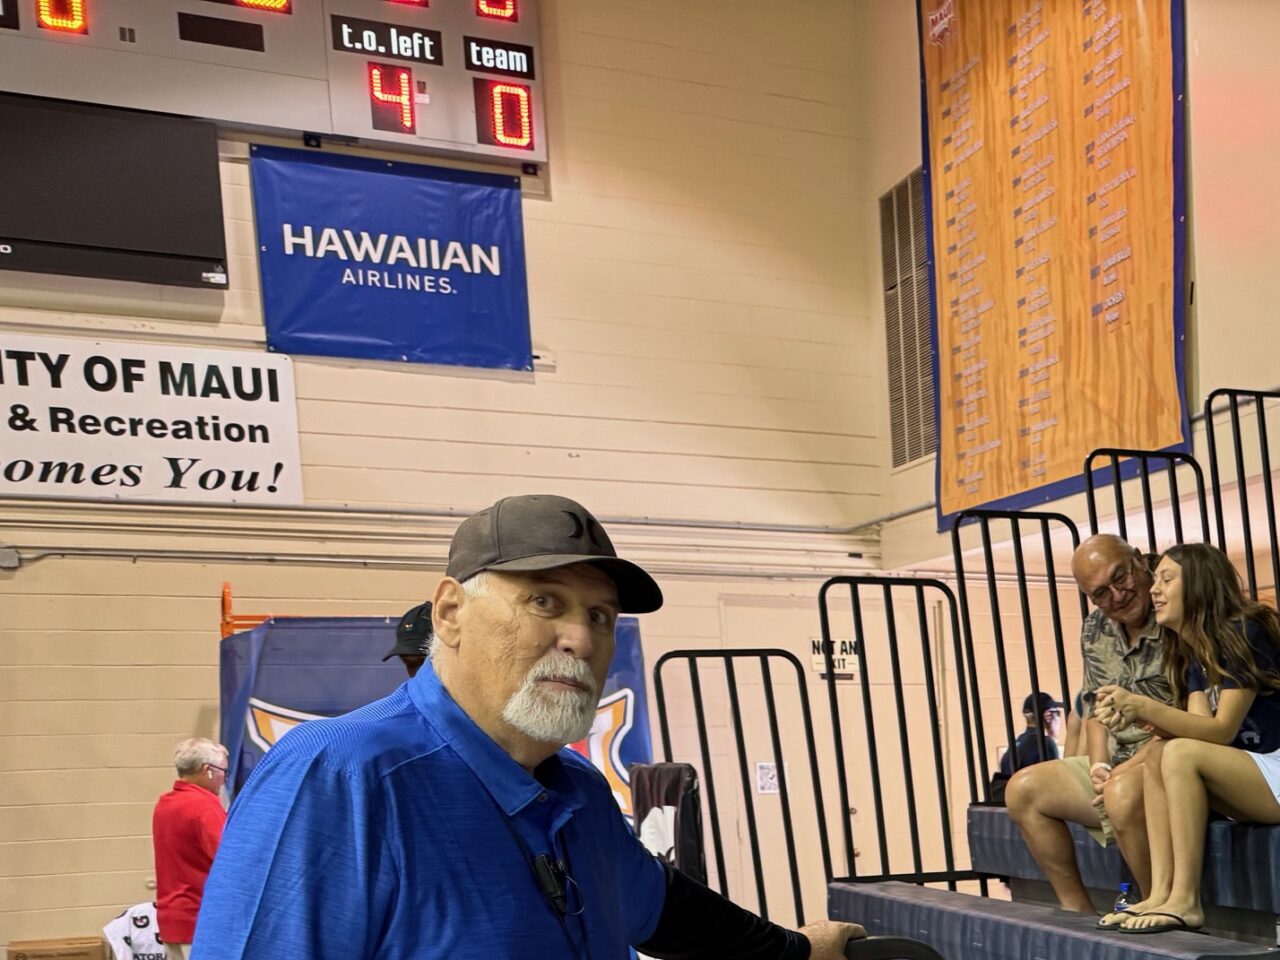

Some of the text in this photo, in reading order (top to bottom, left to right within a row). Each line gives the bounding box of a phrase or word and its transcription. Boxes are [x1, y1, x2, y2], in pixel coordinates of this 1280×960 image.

[341, 23, 435, 60] t.o. left
[470, 42, 528, 73] team
[371, 67, 413, 129] 4
[492, 84, 532, 147] 0
[283, 223, 500, 276] HAWAIIAN
[83, 355, 146, 393] OF
[158, 361, 280, 402] MAUI
[8, 404, 270, 443] & Recreation
[162, 456, 284, 493] You!
[812, 640, 835, 655] NT
